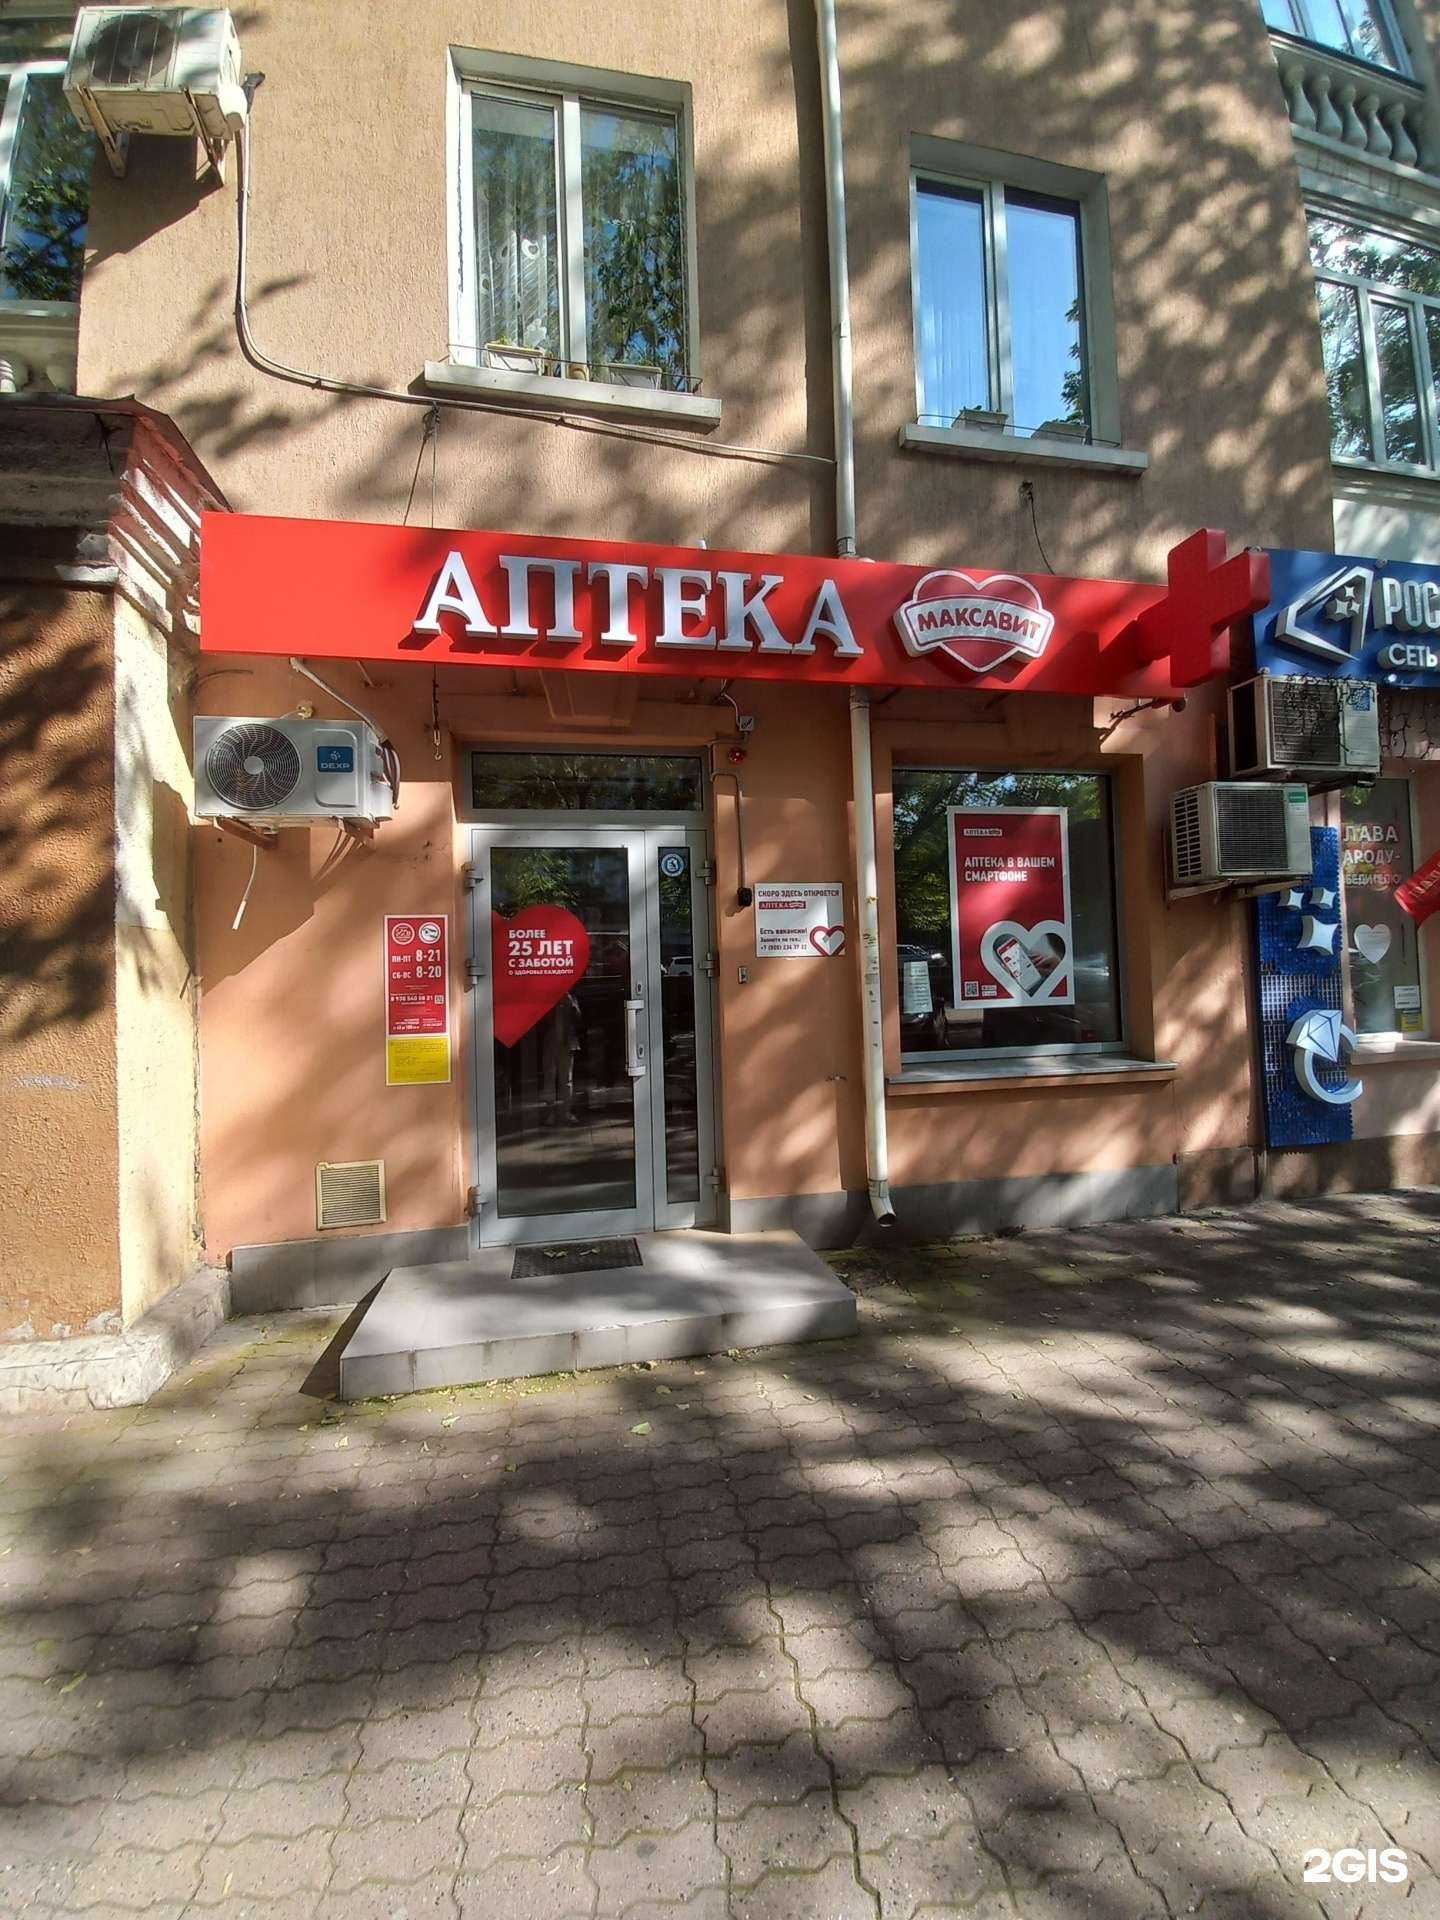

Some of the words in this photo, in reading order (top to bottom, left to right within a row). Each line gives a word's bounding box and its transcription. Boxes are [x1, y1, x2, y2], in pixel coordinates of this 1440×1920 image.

[413, 551, 864, 657] АПТЕКА
[917, 608, 1041, 639] МАКСАВИТ
[1387, 643, 1438, 667] СЕТЬ
[1343, 825, 1399, 842] ЛАВА
[964, 857, 1005, 868] АПТЕКА
[1007, 857, 1014, 868] В
[1017, 857, 1055, 868] ВАШЕМ
[1342, 849, 1400, 866] АРОДУ-
[965, 871, 1028, 882] СМАРТФОНЕ
[1345, 873, 1400, 885] БЕДИТЕЛЮ
[781, 890, 802, 898] ЗДЕСЬ
[508, 929, 546, 939] БОЛЕЕ
[508, 941, 533, 956] 25
[537, 940, 573, 955] ЛЕТ
[391, 955, 411, 963] ПН-ПТ
[416, 949, 441, 962] 8-21
[508, 958, 516, 968] С
[519, 955, 574, 967] ЗАБОТОЙ
[416, 966, 442, 978] 8-20
